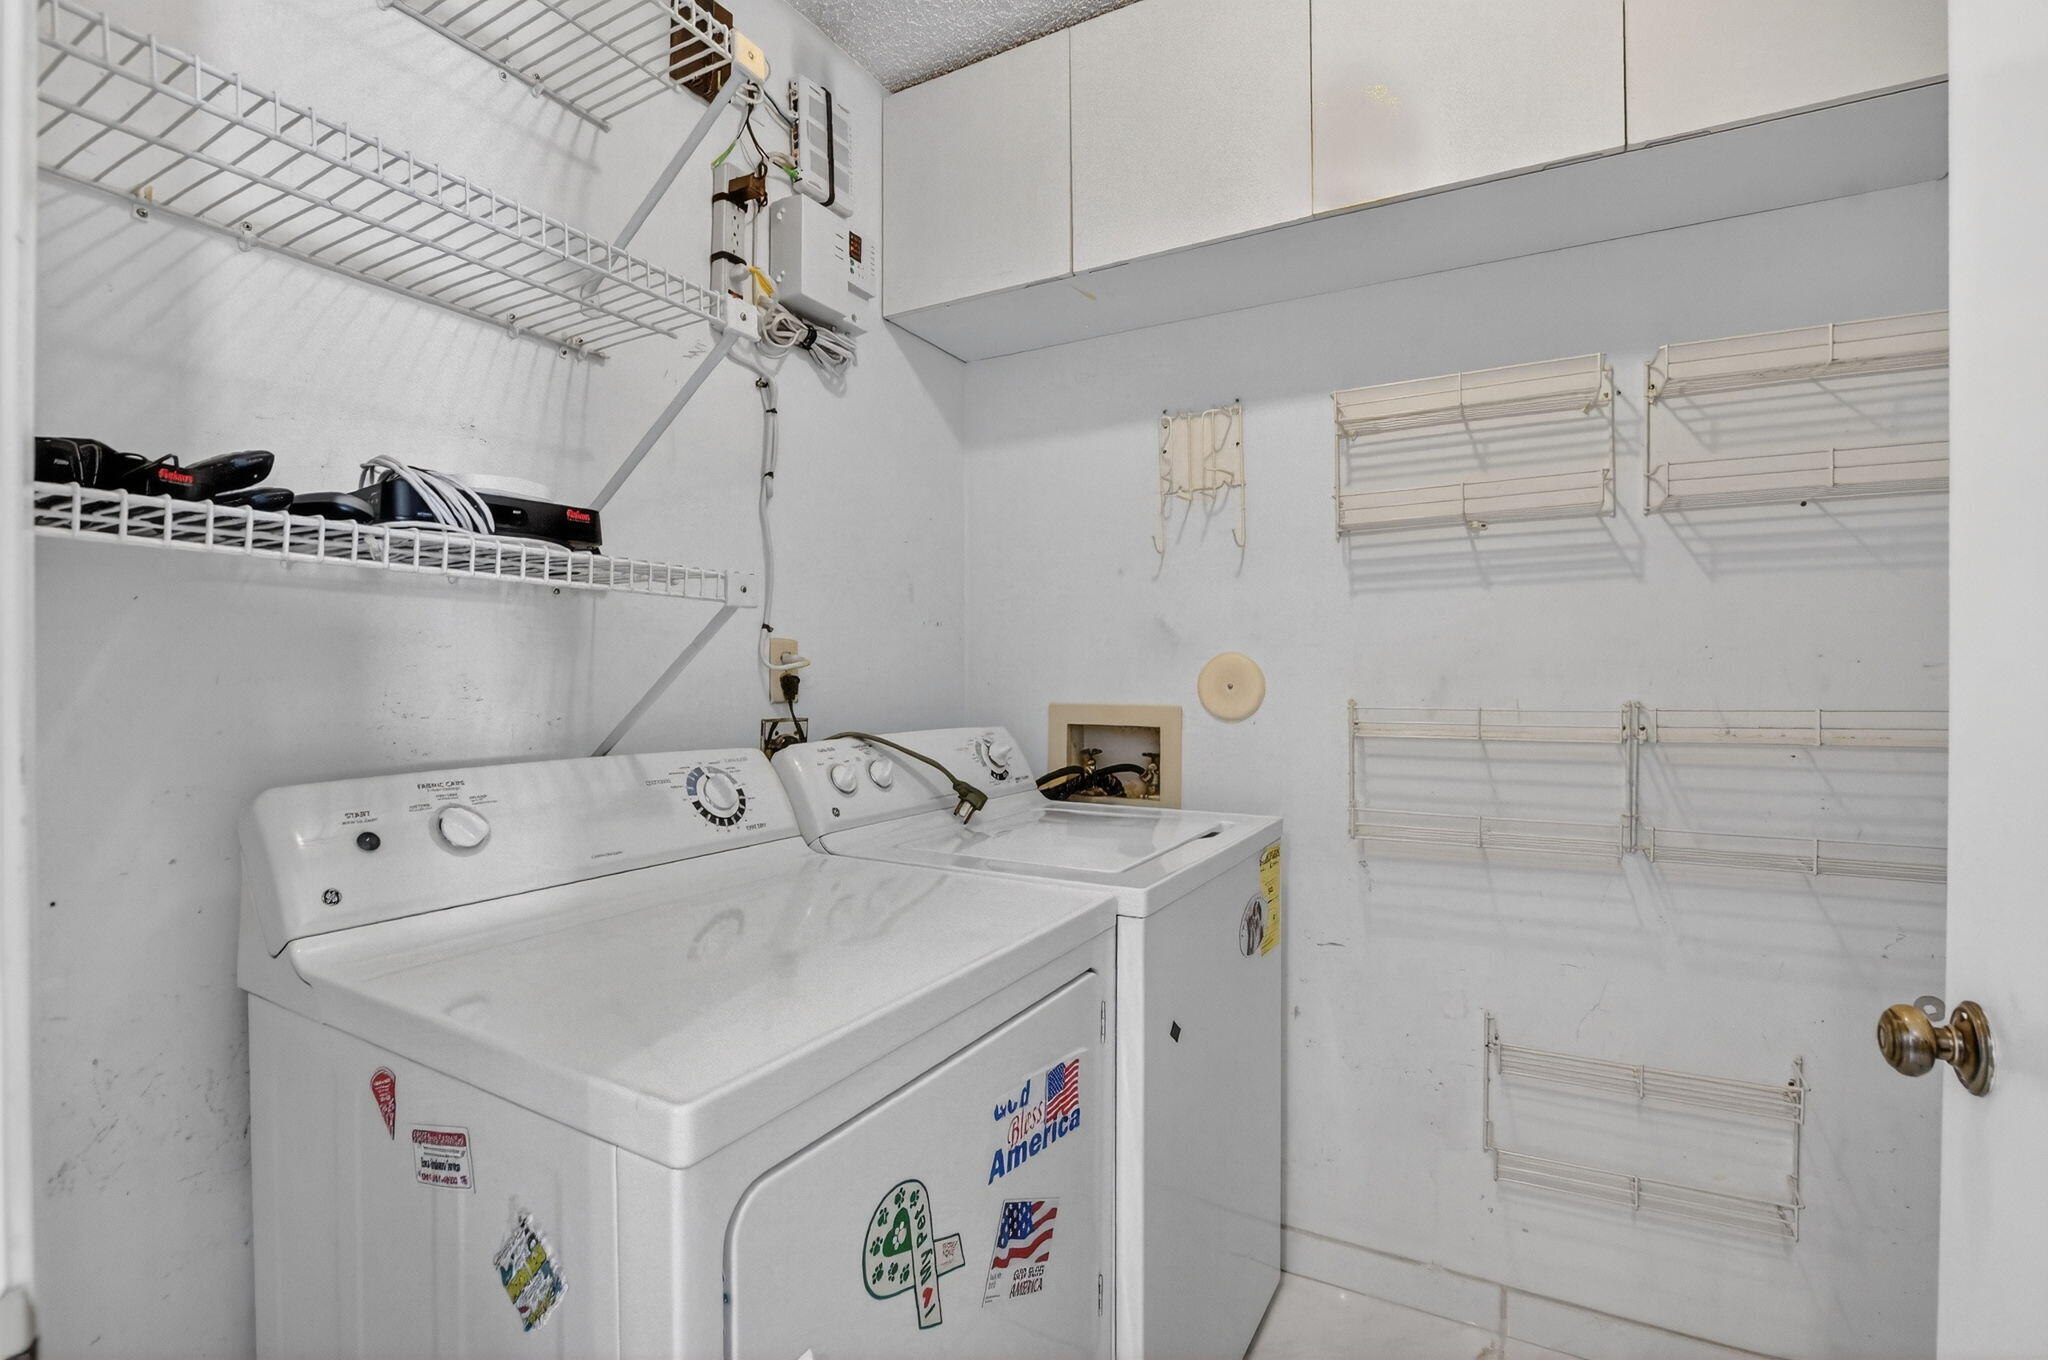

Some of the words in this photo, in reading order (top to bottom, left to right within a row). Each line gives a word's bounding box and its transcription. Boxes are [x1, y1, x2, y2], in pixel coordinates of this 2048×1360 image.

[987, 1107, 1081, 1186] America
[1007, 1100, 1044, 1150] Bless
[913, 1203, 928, 1249] Pet
[919, 1248, 933, 1287] My
